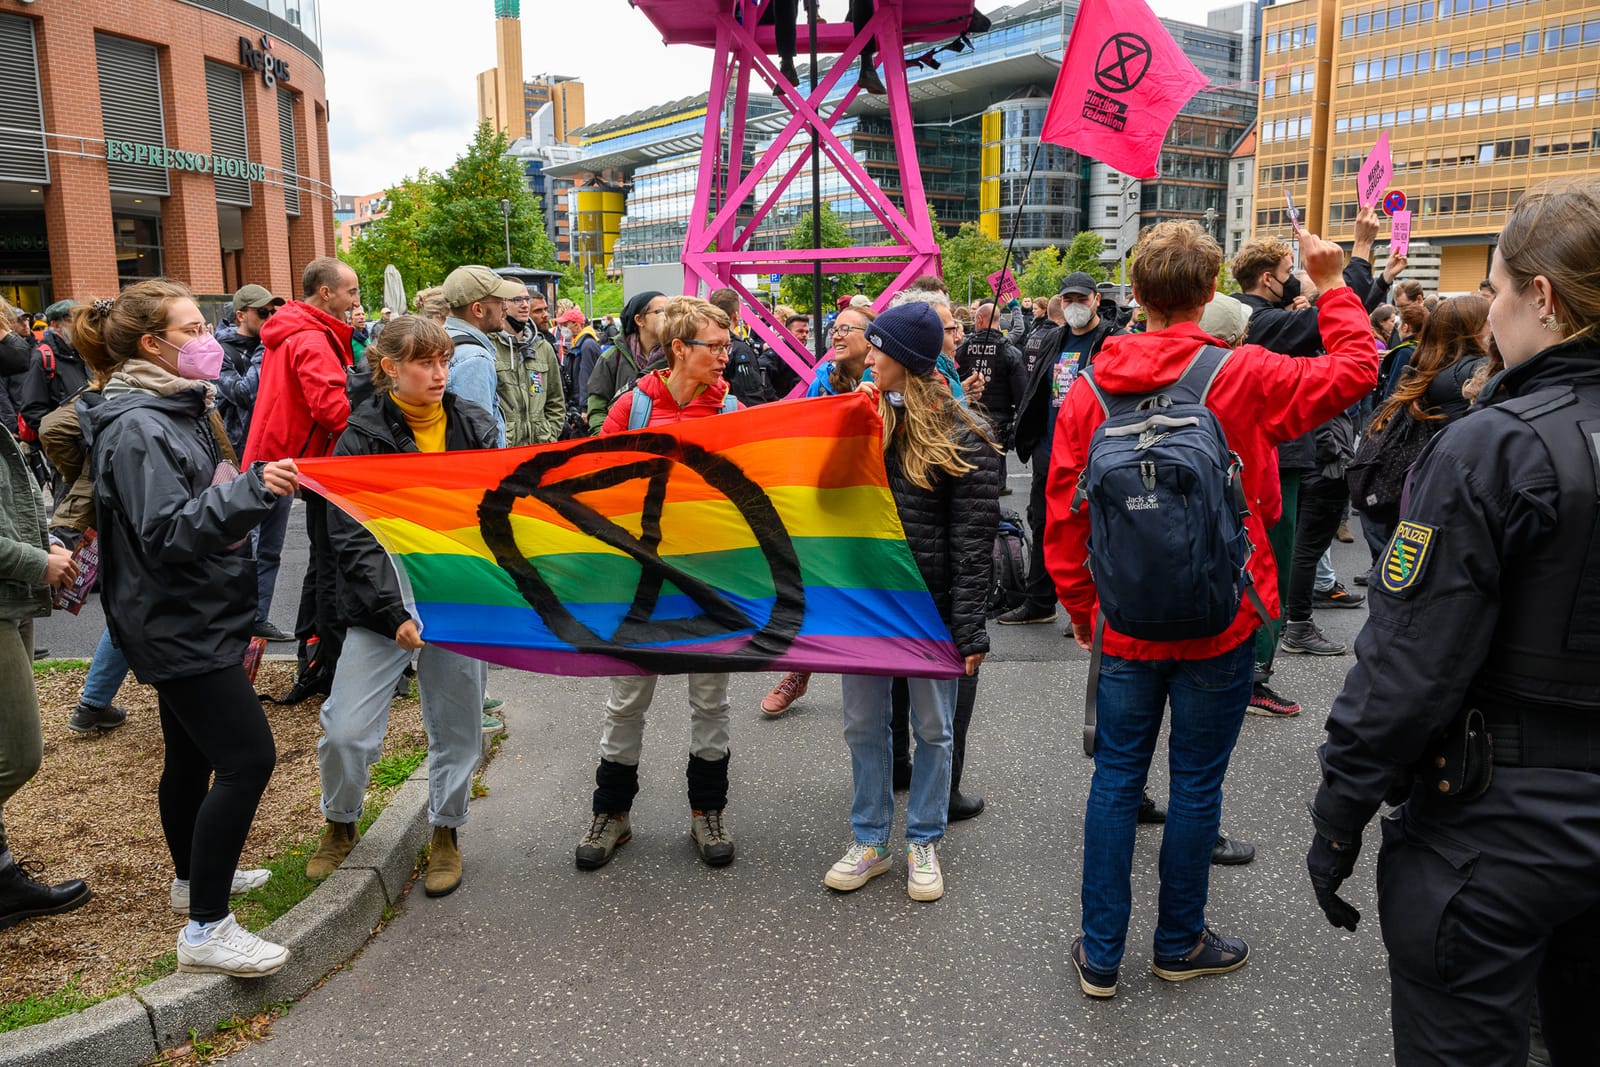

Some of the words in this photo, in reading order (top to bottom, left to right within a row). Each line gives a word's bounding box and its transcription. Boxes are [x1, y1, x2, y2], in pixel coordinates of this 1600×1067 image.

[239, 36, 290, 88] Regus
[1083, 107, 1124, 130] rebellion
[106, 138, 209, 173] ESPRESSO
[212, 154, 265, 182] HOUSE
[1125, 495, 1145, 503] Jack
[1126, 502, 1160, 511] Wolfskin
[1397, 525, 1428, 545] POLIZEI
